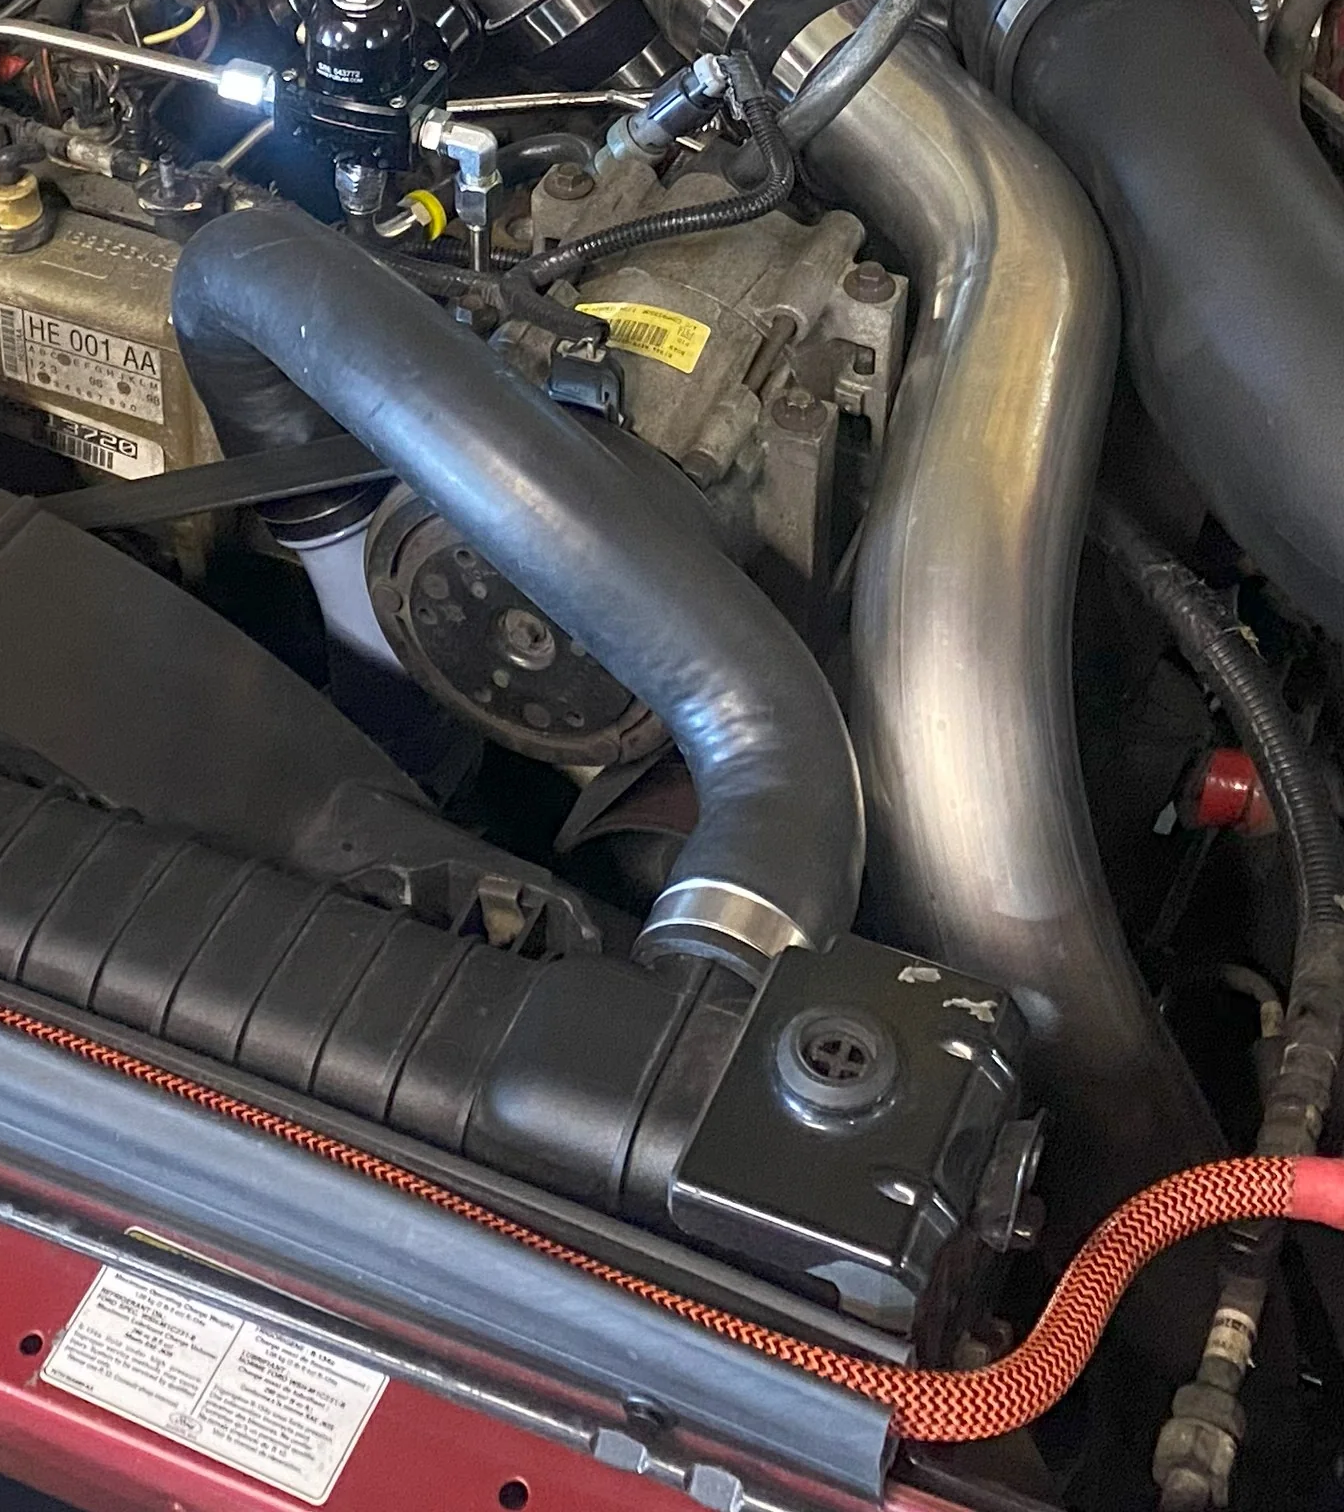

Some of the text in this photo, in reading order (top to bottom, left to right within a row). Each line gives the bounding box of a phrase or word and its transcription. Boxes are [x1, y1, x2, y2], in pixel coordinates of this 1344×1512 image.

[29, 316, 61, 346] HE
[70, 330, 109, 361] 001
[123, 346, 156, 375] AA
